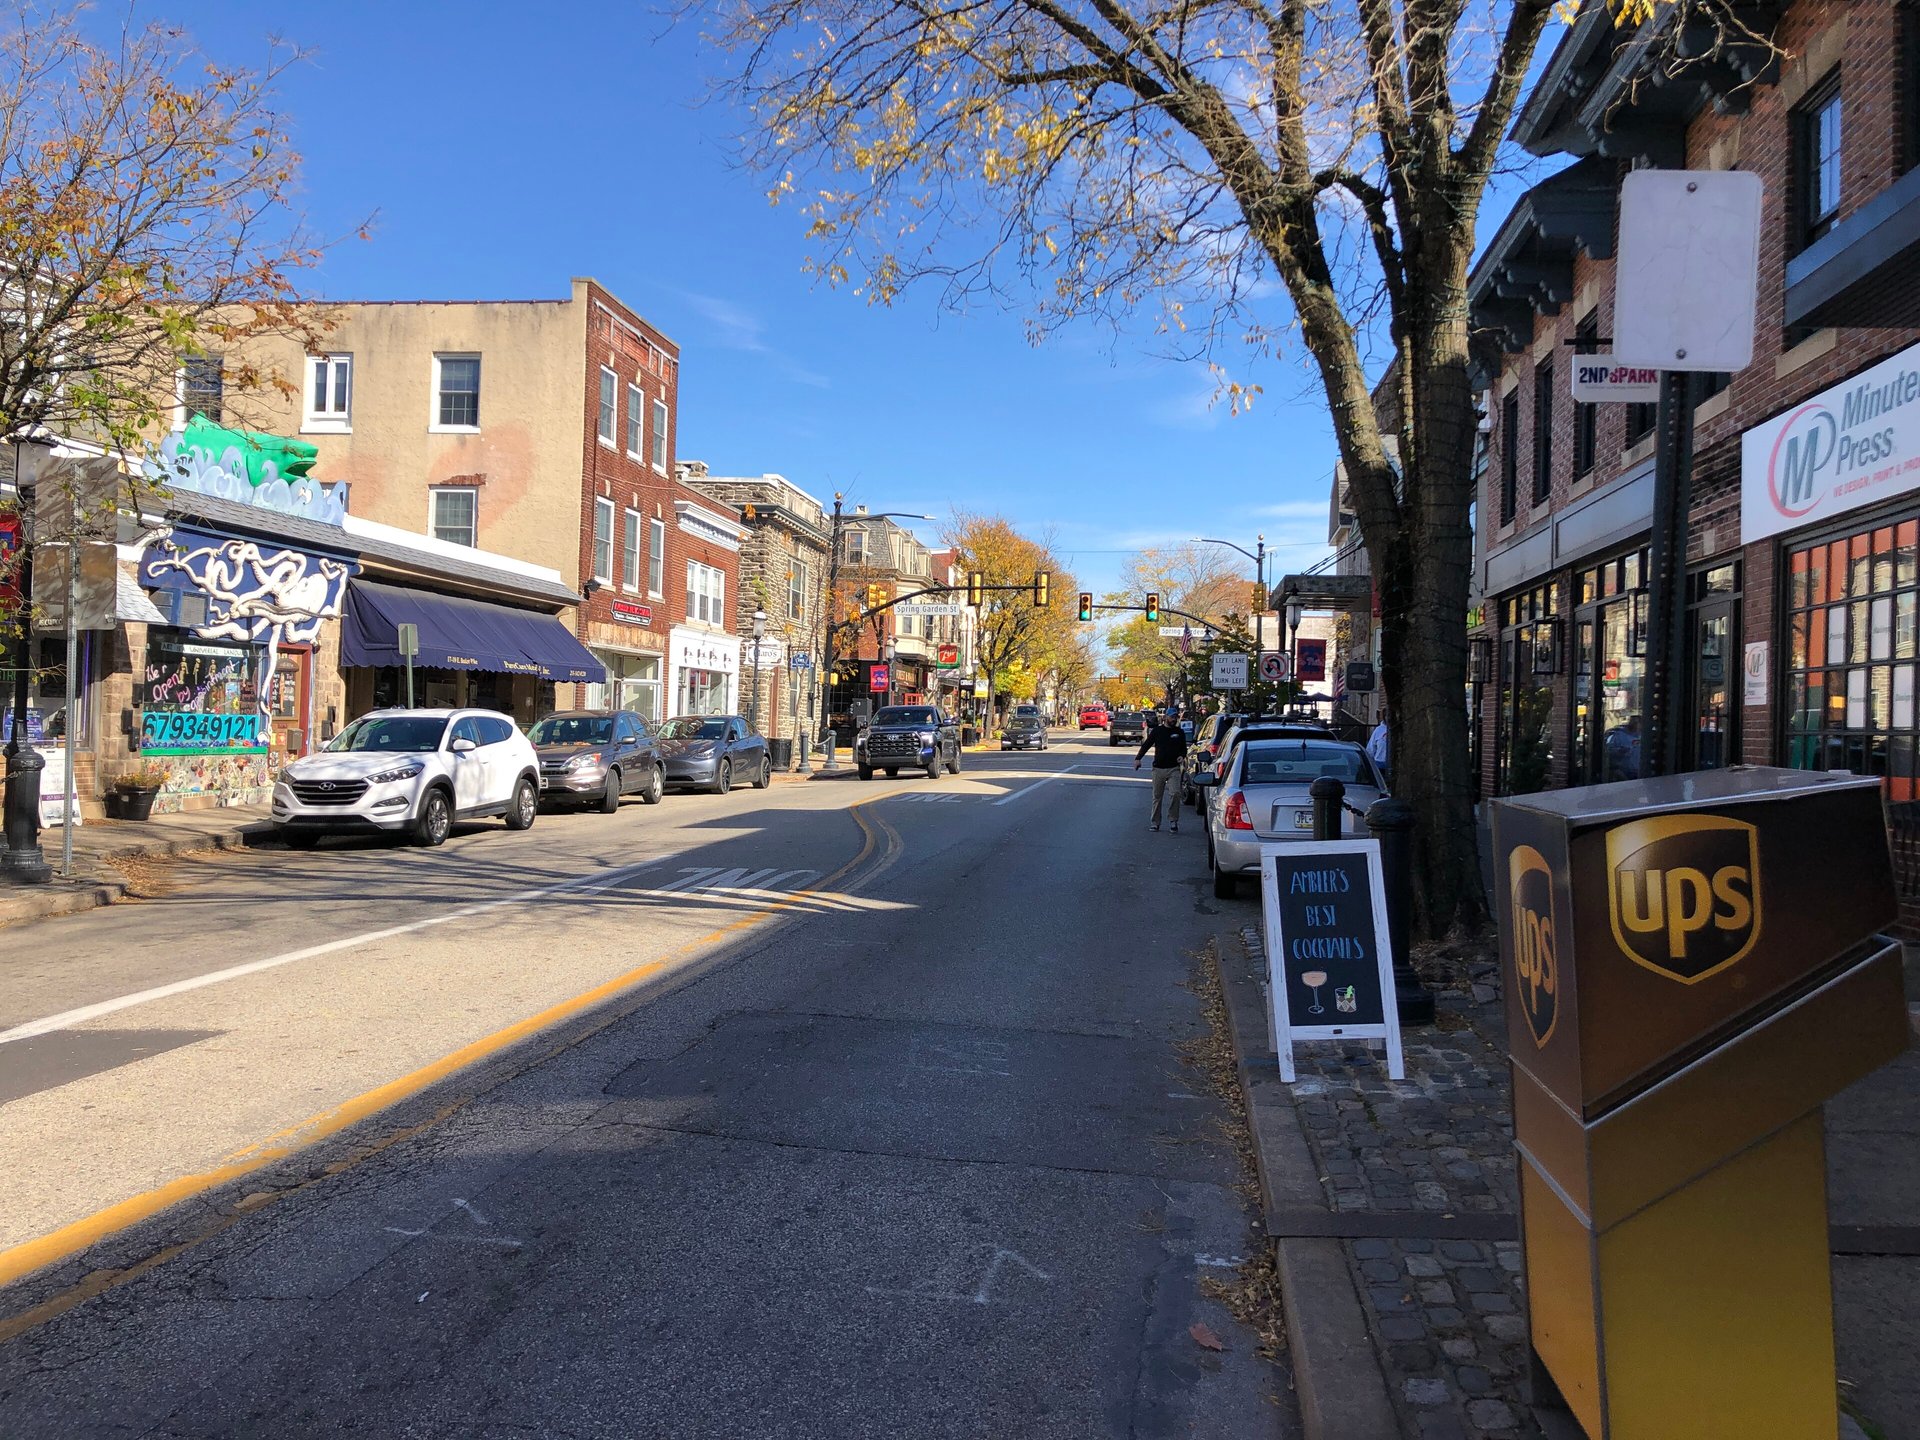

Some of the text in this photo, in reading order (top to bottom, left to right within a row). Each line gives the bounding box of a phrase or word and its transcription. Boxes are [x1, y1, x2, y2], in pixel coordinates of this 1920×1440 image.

[1579, 367, 1658, 383] 2ND SPARK
[1840, 370, 1920, 432] Minute
[1835, 427, 1894, 476] Press
[897, 605, 957, 614] Spring Garden St
[1220, 667, 1240, 675] MUST
[153, 672, 180, 701] Open
[176, 685, 191, 702] by
[142, 713, 256, 741] 679349121
[1290, 868, 1350, 894] AMBLER'S
[1305, 904, 1336, 927] BEST
[1620, 865, 1752, 958] ups
[1292, 936, 1365, 960] COCKTAILS
[1514, 902, 1555, 1016] ups
